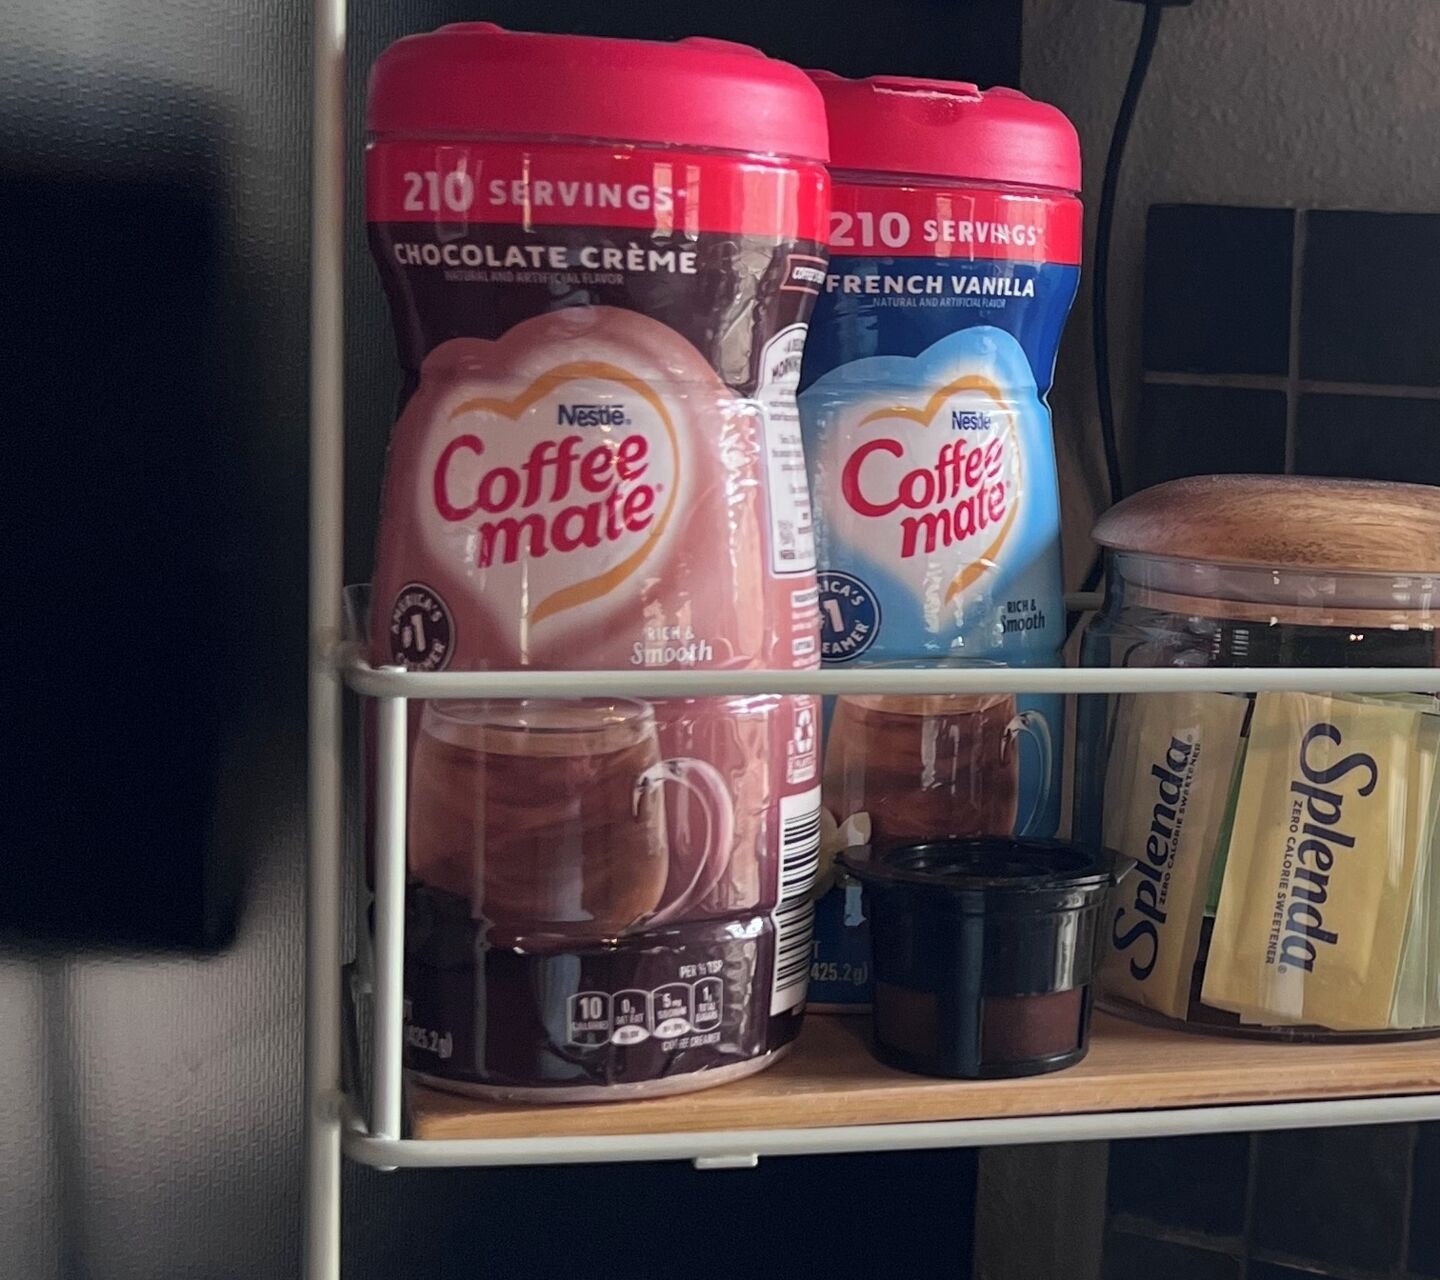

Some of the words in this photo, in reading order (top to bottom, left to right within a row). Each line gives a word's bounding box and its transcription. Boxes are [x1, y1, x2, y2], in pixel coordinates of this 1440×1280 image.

[402, 170, 474, 213] 210
[393, 242, 569, 270] CHOCOLATE
[579, 241, 699, 275] CRÈME
[827, 211, 911, 248] 210
[825, 274, 943, 295] FRENCH
[951, 276, 1036, 298] VANILLA
[434, 433, 649, 522] Coffee
[841, 437, 1003, 518] Coffee
[477, 483, 656, 569] mate
[900, 480, 1007, 559] mate
[631, 639, 713, 665] Smooth
[1000, 611, 1045, 634] Smooth
[1280, 722, 1378, 973] Splenda
[1289, 800, 1303, 833] ZERO
[1113, 736, 1193, 981] Splenda
[1158, 872, 1172, 906] ZERO
[1167, 818, 1184, 870] CALORIE
[1279, 837, 1297, 890] CALORIE
[1265, 893, 1288, 965] SWEETENER
